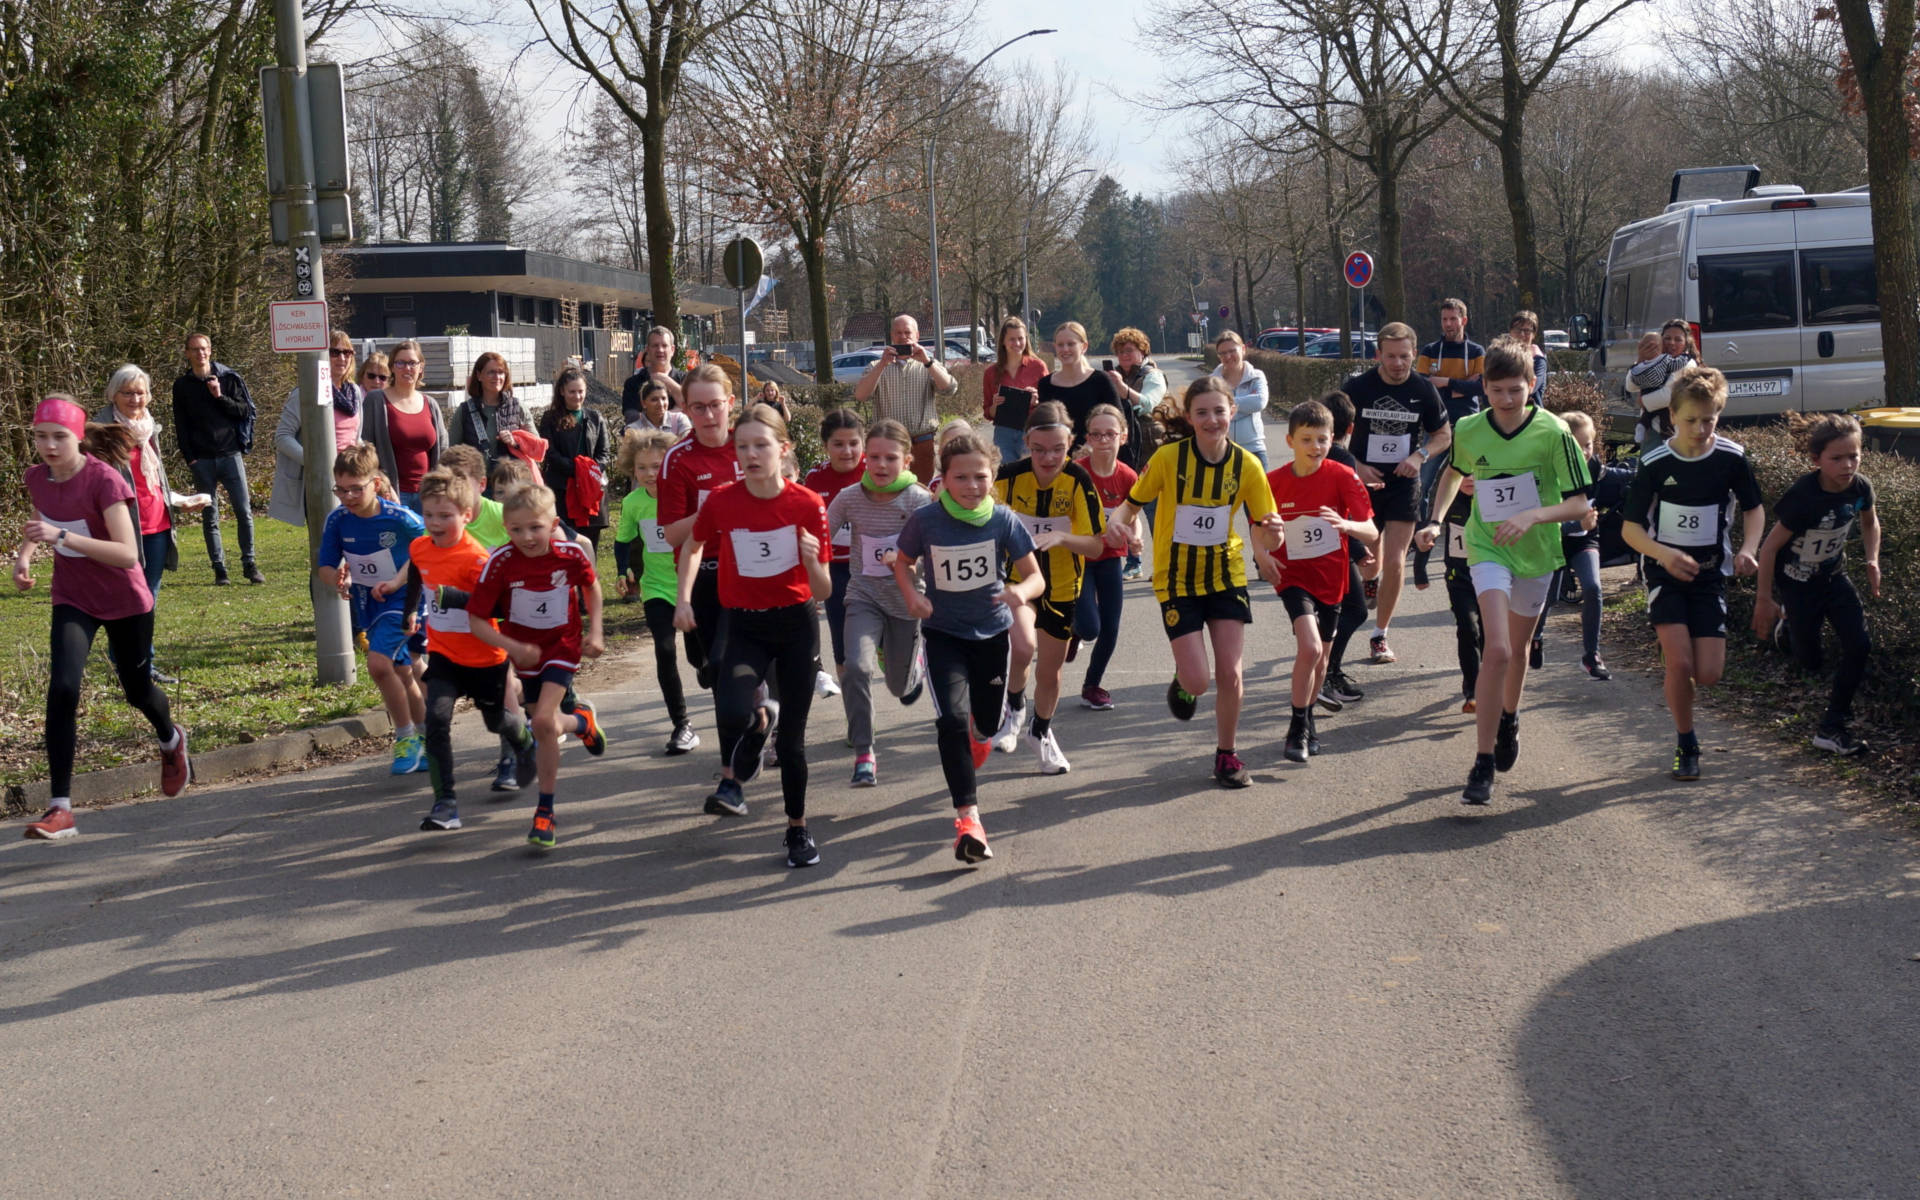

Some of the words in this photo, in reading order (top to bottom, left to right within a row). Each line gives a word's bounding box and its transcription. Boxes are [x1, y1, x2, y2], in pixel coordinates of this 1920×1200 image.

[285, 335, 314, 344] HYDRANT
[1382, 443, 1397, 453] 62
[1494, 487, 1516, 503] 37
[1193, 516, 1215, 529] 40
[1677, 514, 1699, 529] 28
[1303, 528, 1323, 543] 39
[759, 542, 771, 557] 3
[358, 563, 378, 575] 20
[940, 555, 988, 581] 153
[536, 602, 547, 615] 4
